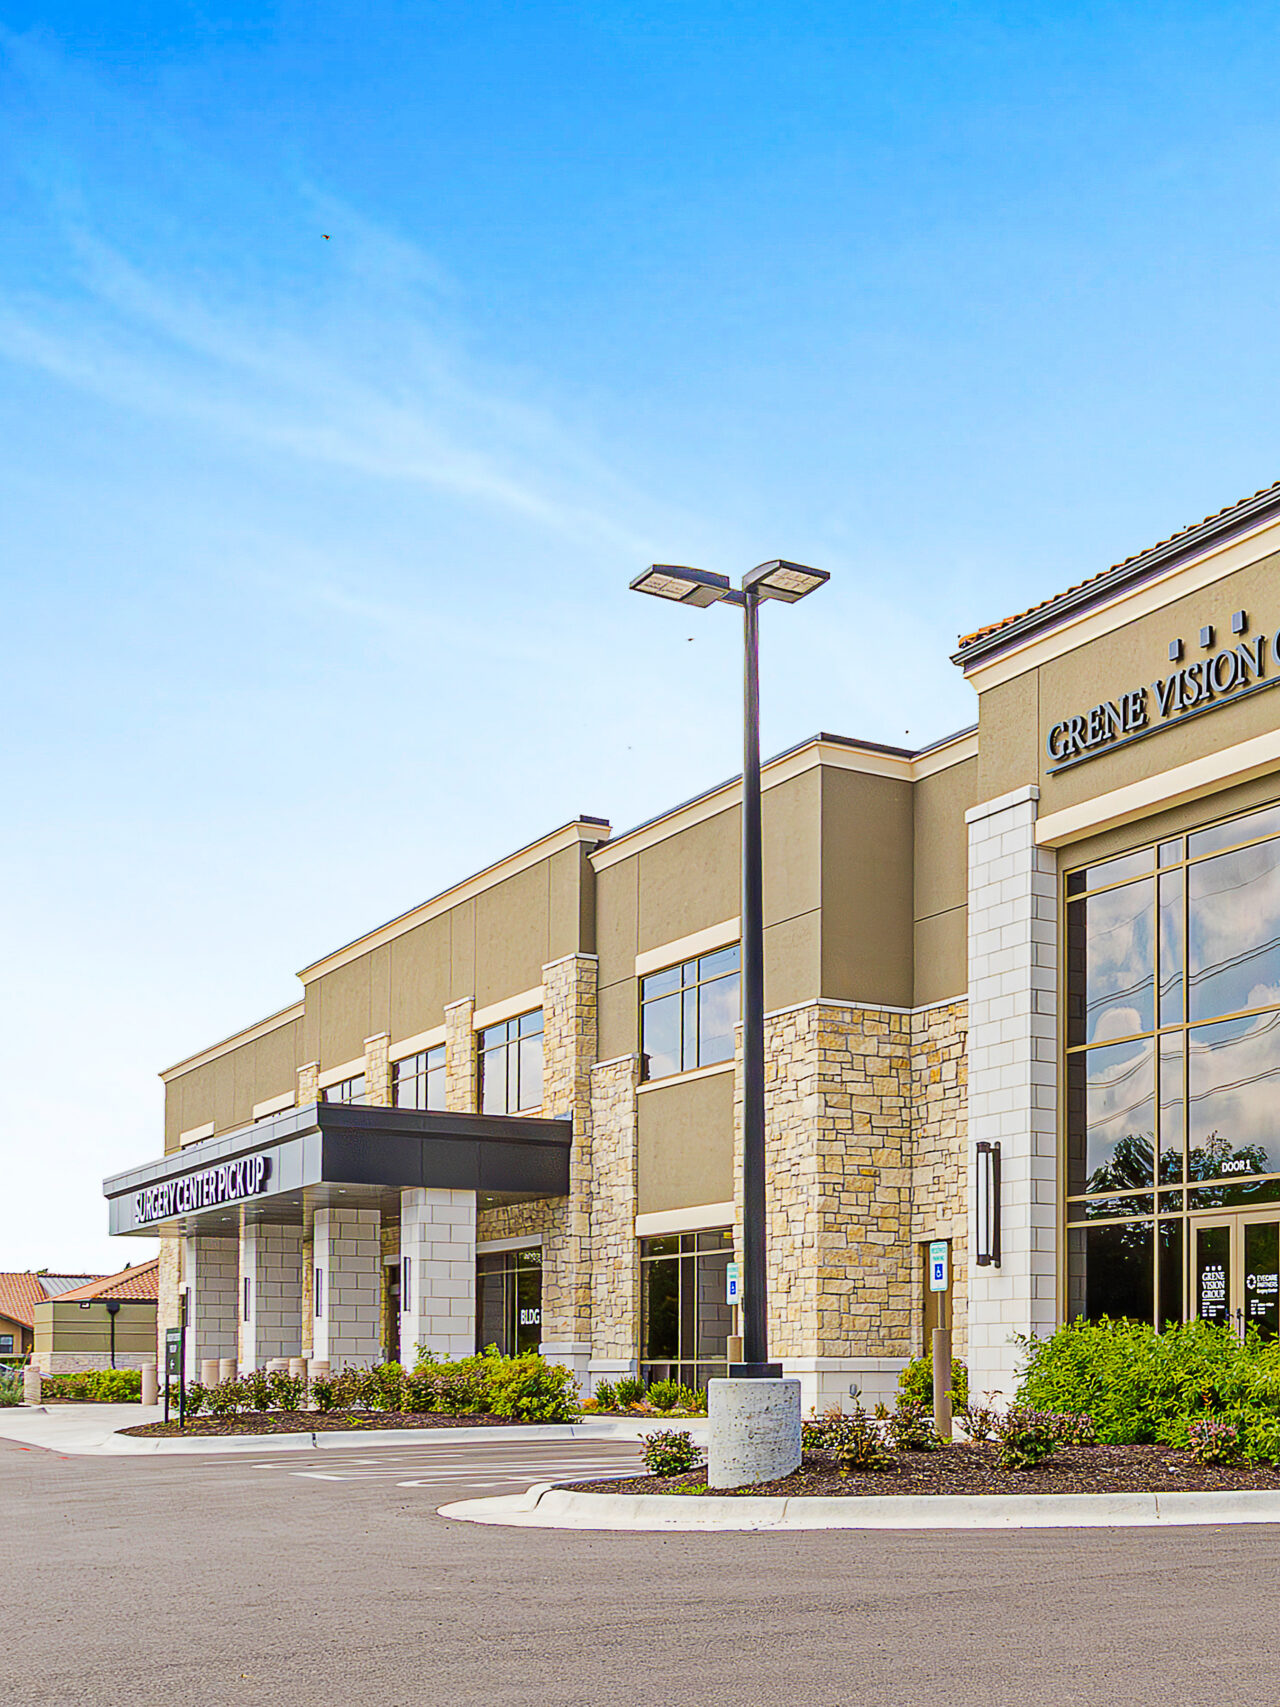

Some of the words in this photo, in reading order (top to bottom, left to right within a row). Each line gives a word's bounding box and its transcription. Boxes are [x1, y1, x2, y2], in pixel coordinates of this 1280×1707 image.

[1045, 686, 1151, 762] GRENE
[1151, 634, 1268, 718] VISION
[1221, 1160, 1245, 1173] DOOR
[1245, 1159, 1251, 1170] 1
[134, 1183, 176, 1223] SURGERY
[176, 1169, 217, 1214] CENTER
[217, 1160, 245, 1202] PICK
[246, 1156, 266, 1195] UP
[1202, 1271, 1226, 1281] GRENE
[1202, 1280, 1226, 1290] VISION
[1202, 1289, 1226, 1299] GROUP
[520, 1308, 540, 1325] BLDG
